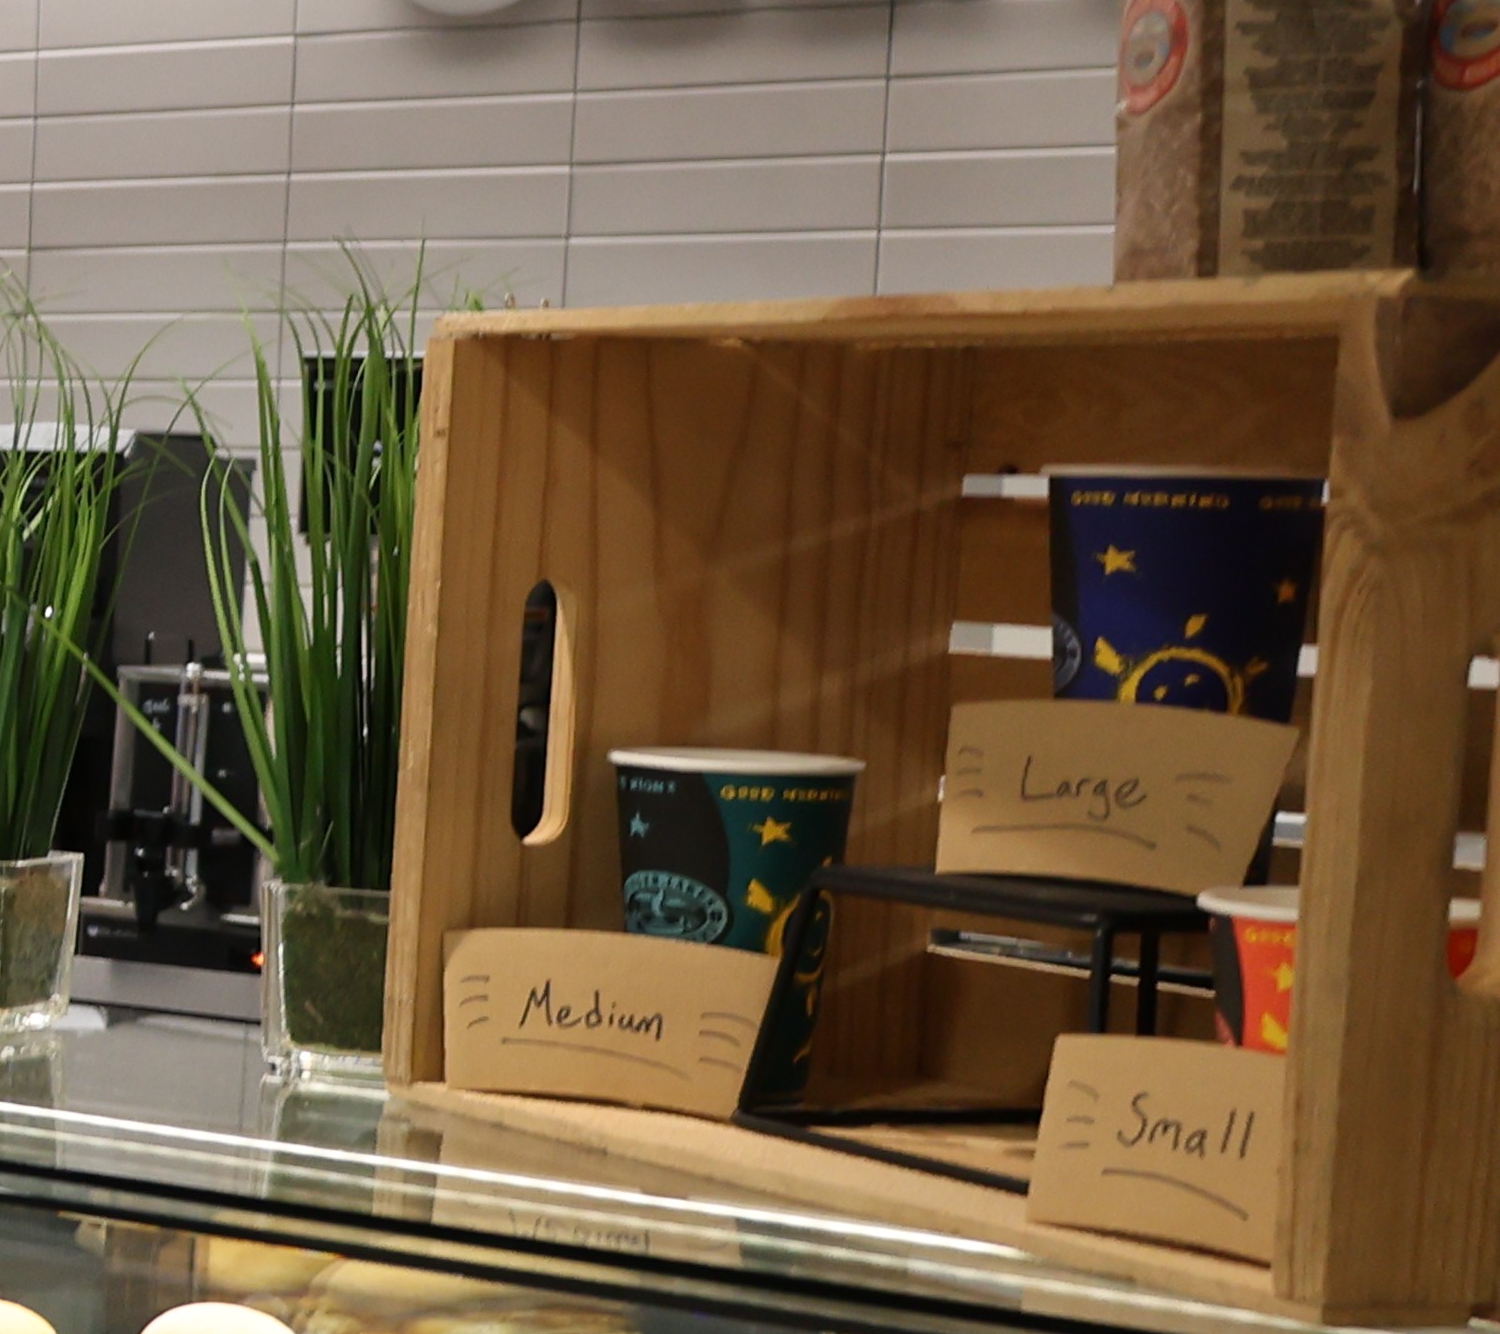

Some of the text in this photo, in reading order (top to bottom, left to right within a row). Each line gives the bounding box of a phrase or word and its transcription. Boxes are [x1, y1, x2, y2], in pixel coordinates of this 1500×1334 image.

[1020, 755, 1148, 821] Large
[518, 974, 664, 1041] Medium
[1116, 1094, 1255, 1158] Small
